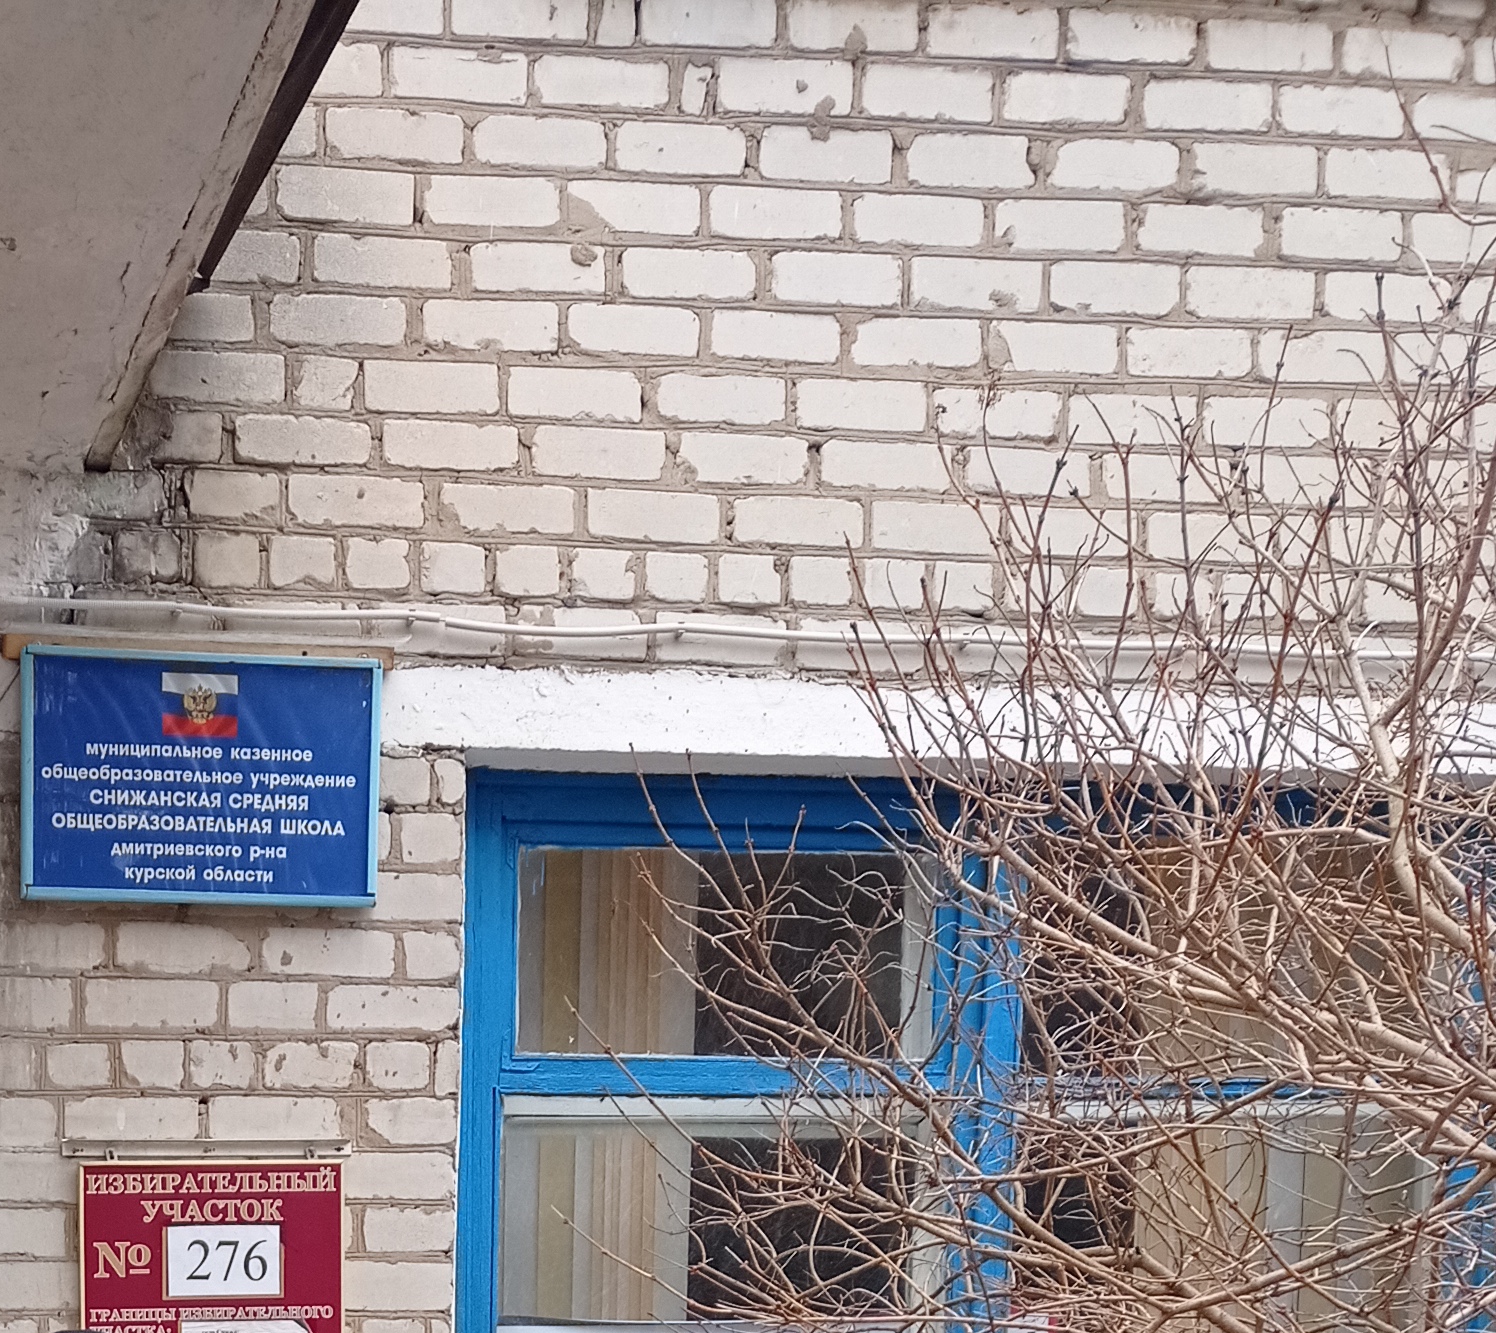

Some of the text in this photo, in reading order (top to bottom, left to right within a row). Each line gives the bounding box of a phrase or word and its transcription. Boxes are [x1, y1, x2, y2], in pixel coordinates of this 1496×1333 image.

[86, 741, 313, 762] муниципальное казенное
[41, 764, 356, 790] общеобразовательное учреждение
[89, 789, 309, 812] СНИЖАНСКАЯ СРЕДНЯЯ
[52, 813, 345, 836] ОБЩЕОБРАЗОВАТЕЛЬНАЯ ШКОЛА
[110, 841, 287, 860] дмитриевского р-на
[124, 865, 273, 883] курской области
[86, 1166, 337, 1195] ИЗБИРАТЕЛЬНЫЙ
[140, 1198, 284, 1223] УЧАСТОК
[93, 1239, 268, 1282] № 276
[89, 1305, 333, 1323] ГРАНИЦЫ ИЗБИРАТЕЛЬНОГО
